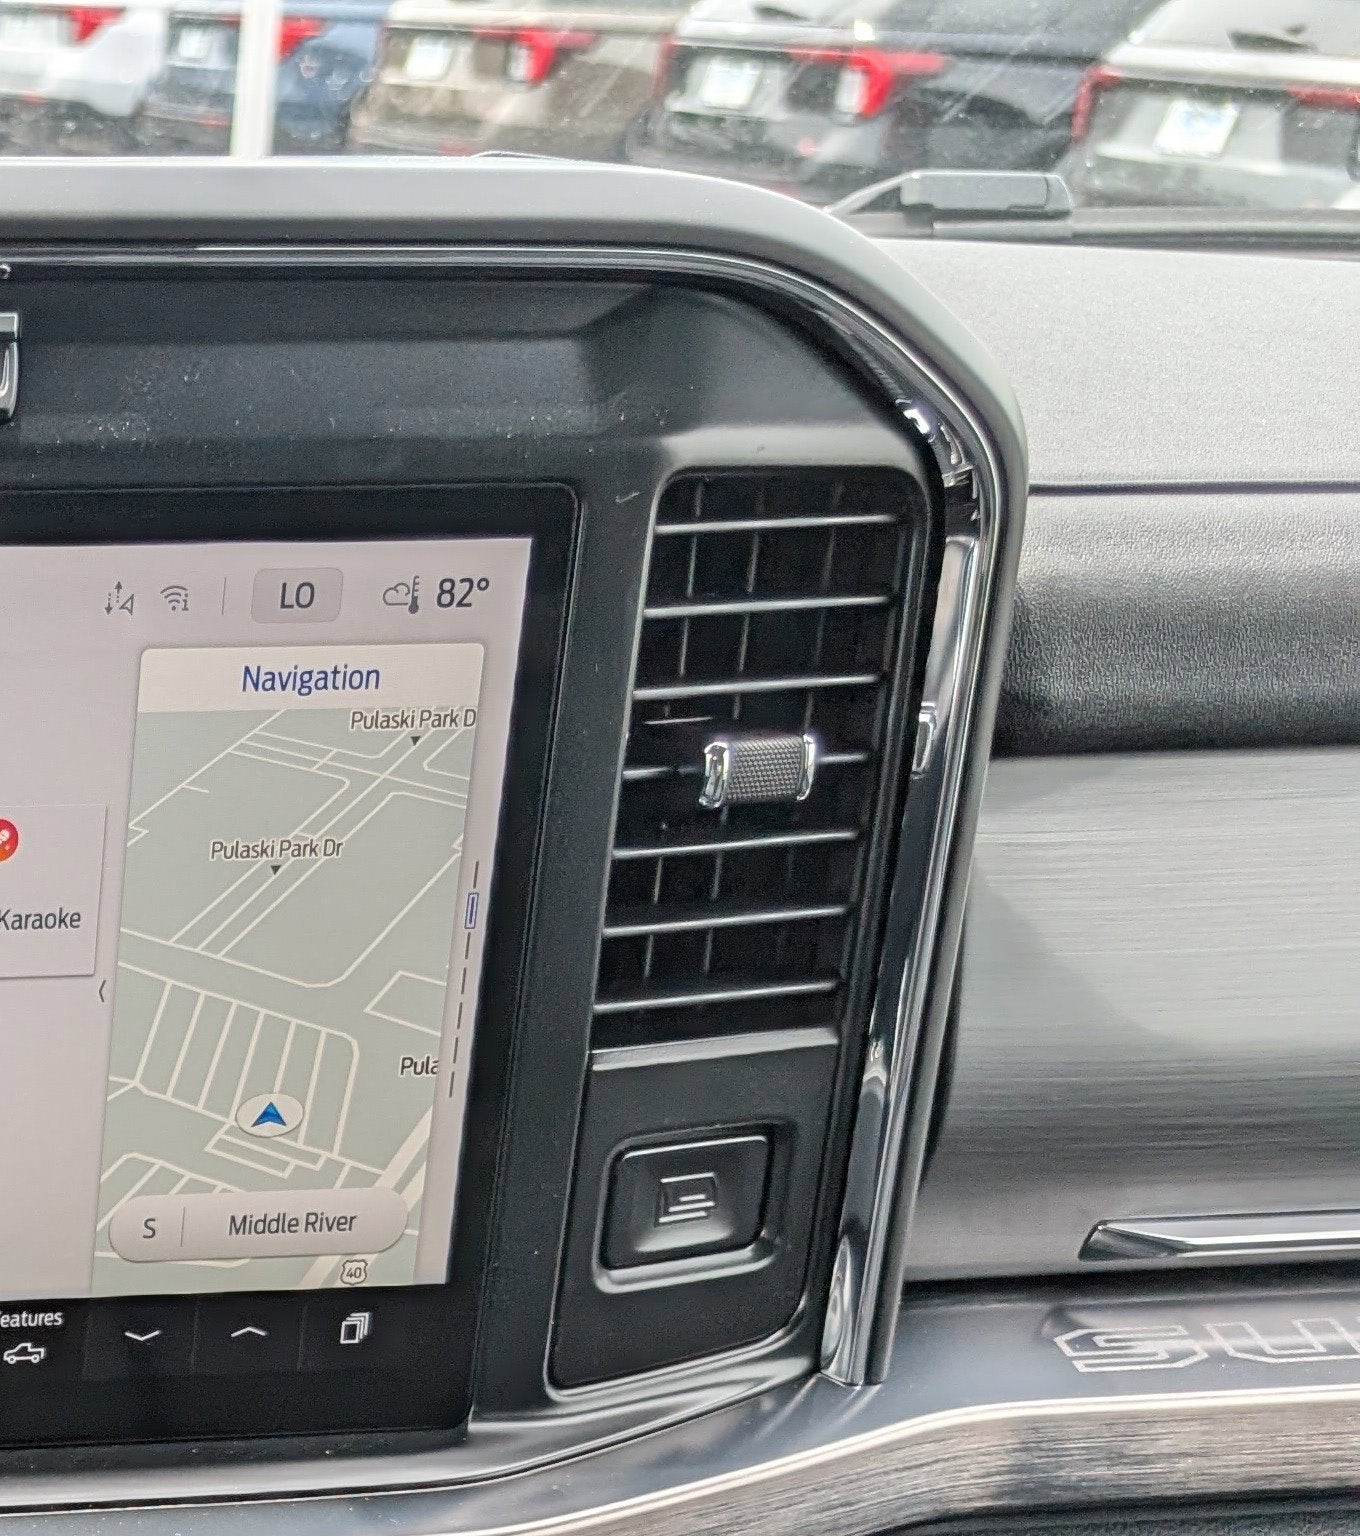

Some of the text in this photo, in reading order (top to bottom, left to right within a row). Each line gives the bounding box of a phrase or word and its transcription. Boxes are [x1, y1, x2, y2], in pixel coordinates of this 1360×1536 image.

[281, 582, 314, 608] LO
[437, 578, 489, 608] 82°
[243, 664, 379, 696] Navigation
[351, 710, 415, 729] Pulaski
[420, 709, 458, 728] Park
[212, 839, 343, 859] Pulaski Park Dr
[143, 1218, 156, 1239] S
[229, 1212, 357, 1235] Middle River
